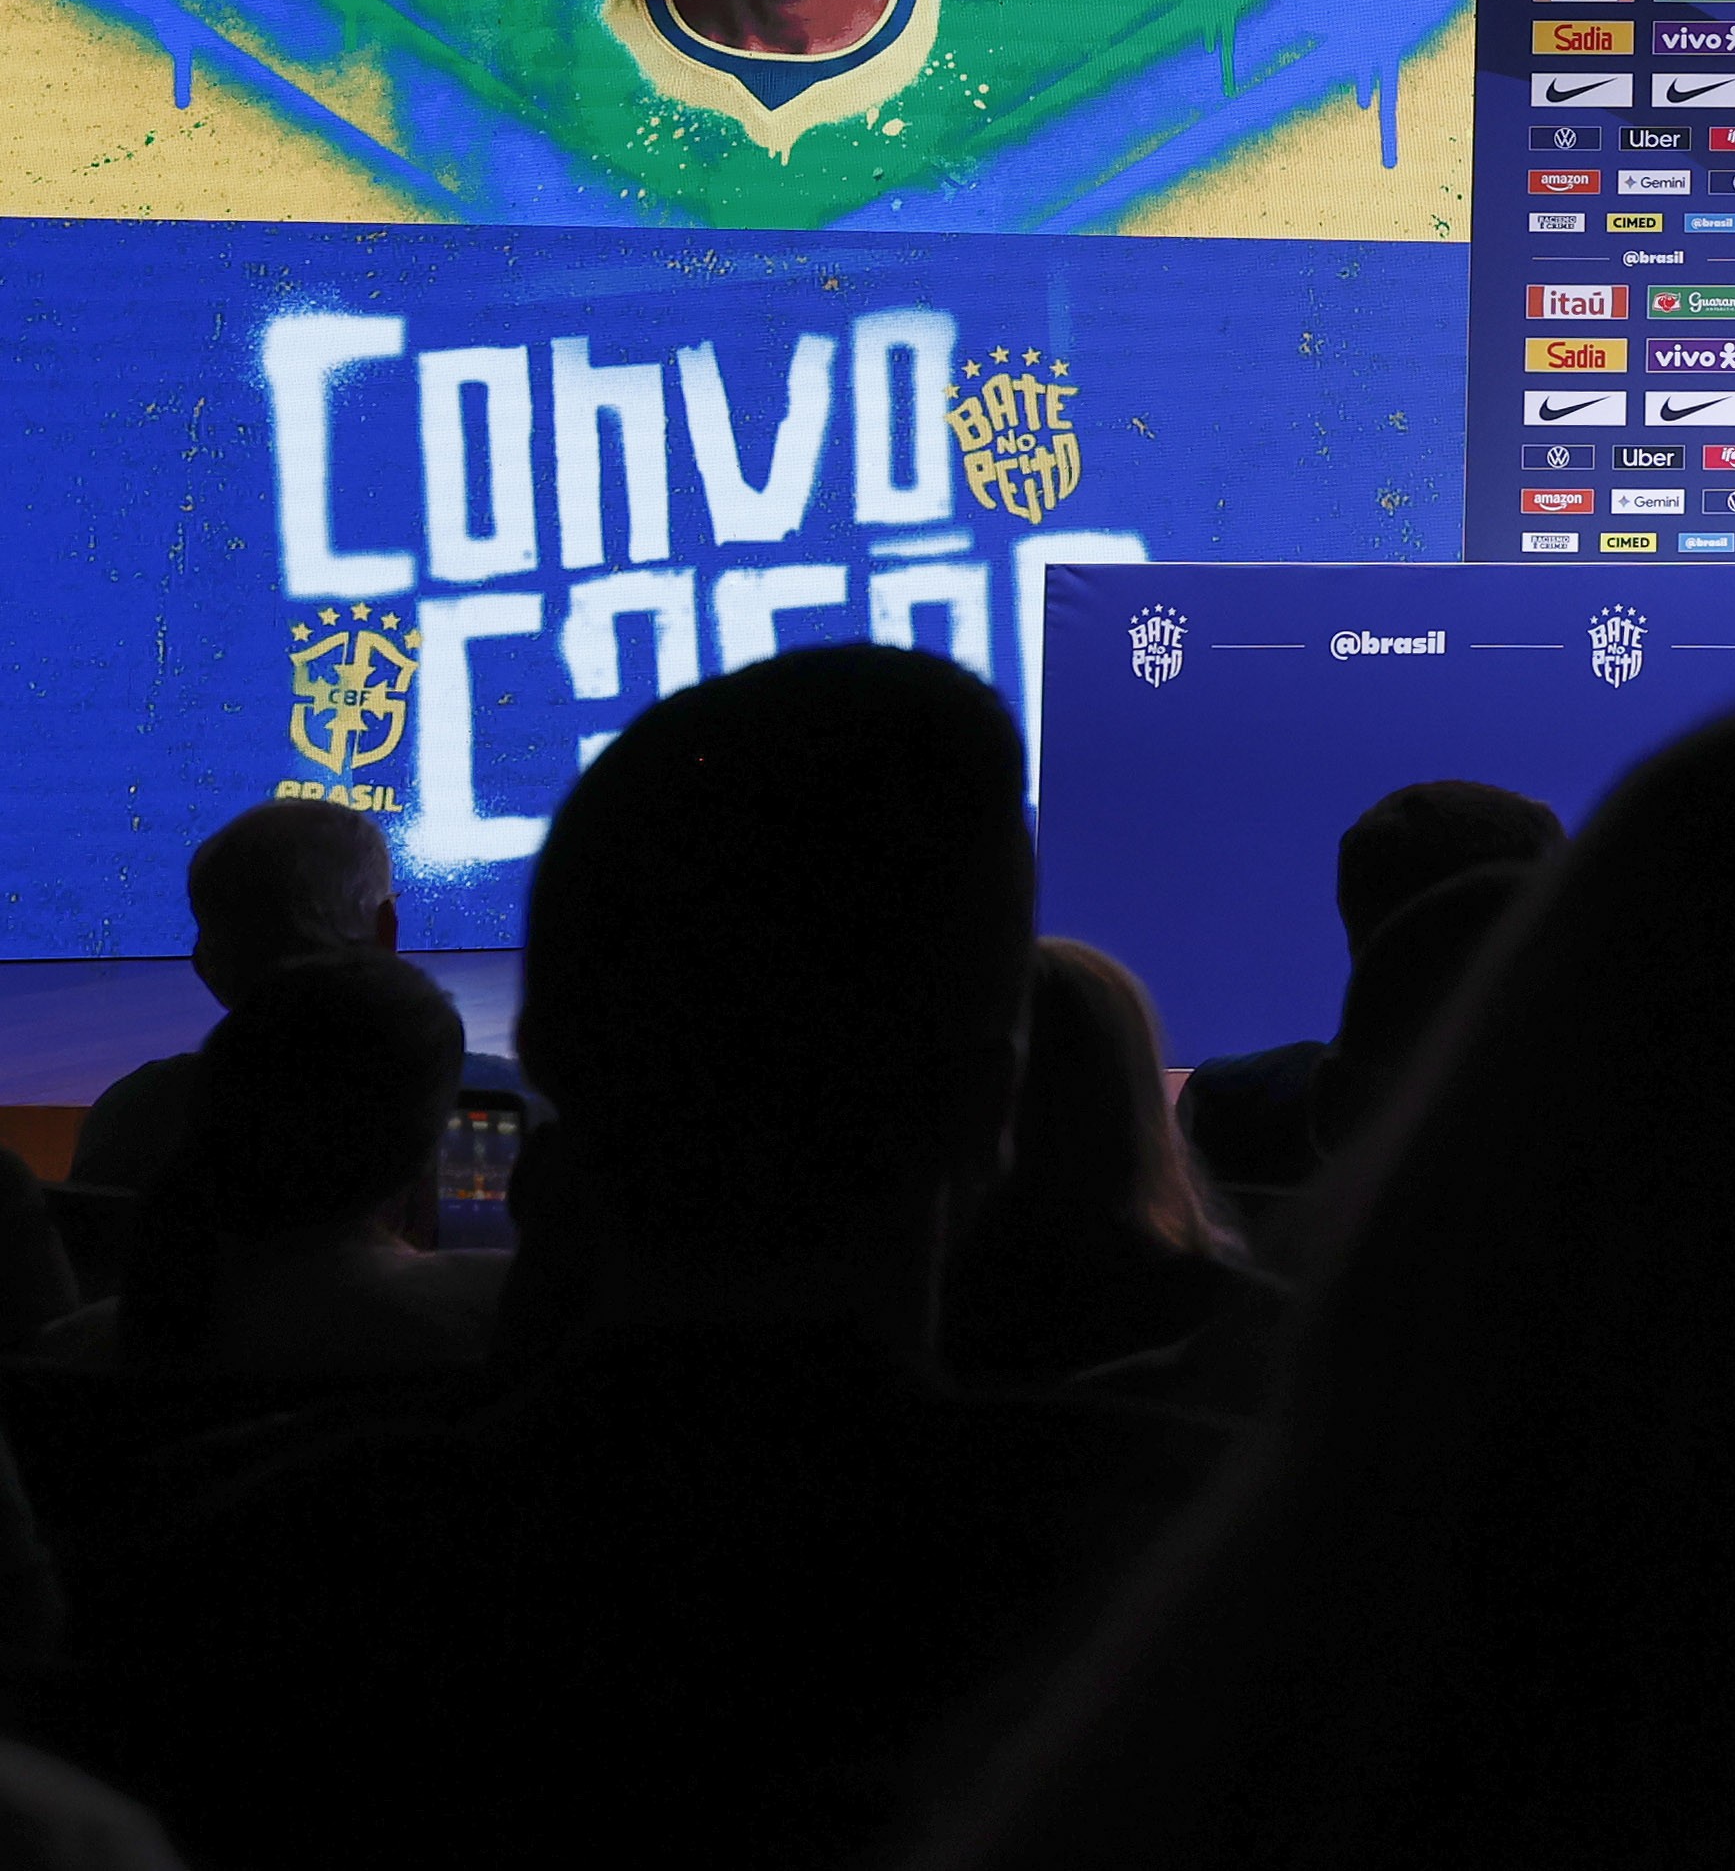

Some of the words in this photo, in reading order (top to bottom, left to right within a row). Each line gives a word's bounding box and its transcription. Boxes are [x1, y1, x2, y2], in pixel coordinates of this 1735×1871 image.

[1630, 130, 1680, 147] Uber
[1613, 218, 1656, 228] CIMED
[1623, 251, 1683, 266] @brasil
[944, 373, 1079, 452] BATE
[997, 429, 1037, 454] NO
[1128, 617, 1188, 649] BATE
[1588, 617, 1648, 649] BATE
[1148, 643, 1166, 654] NO
[1331, 631, 1445, 660] @brasil
[1608, 643, 1626, 654] NO
